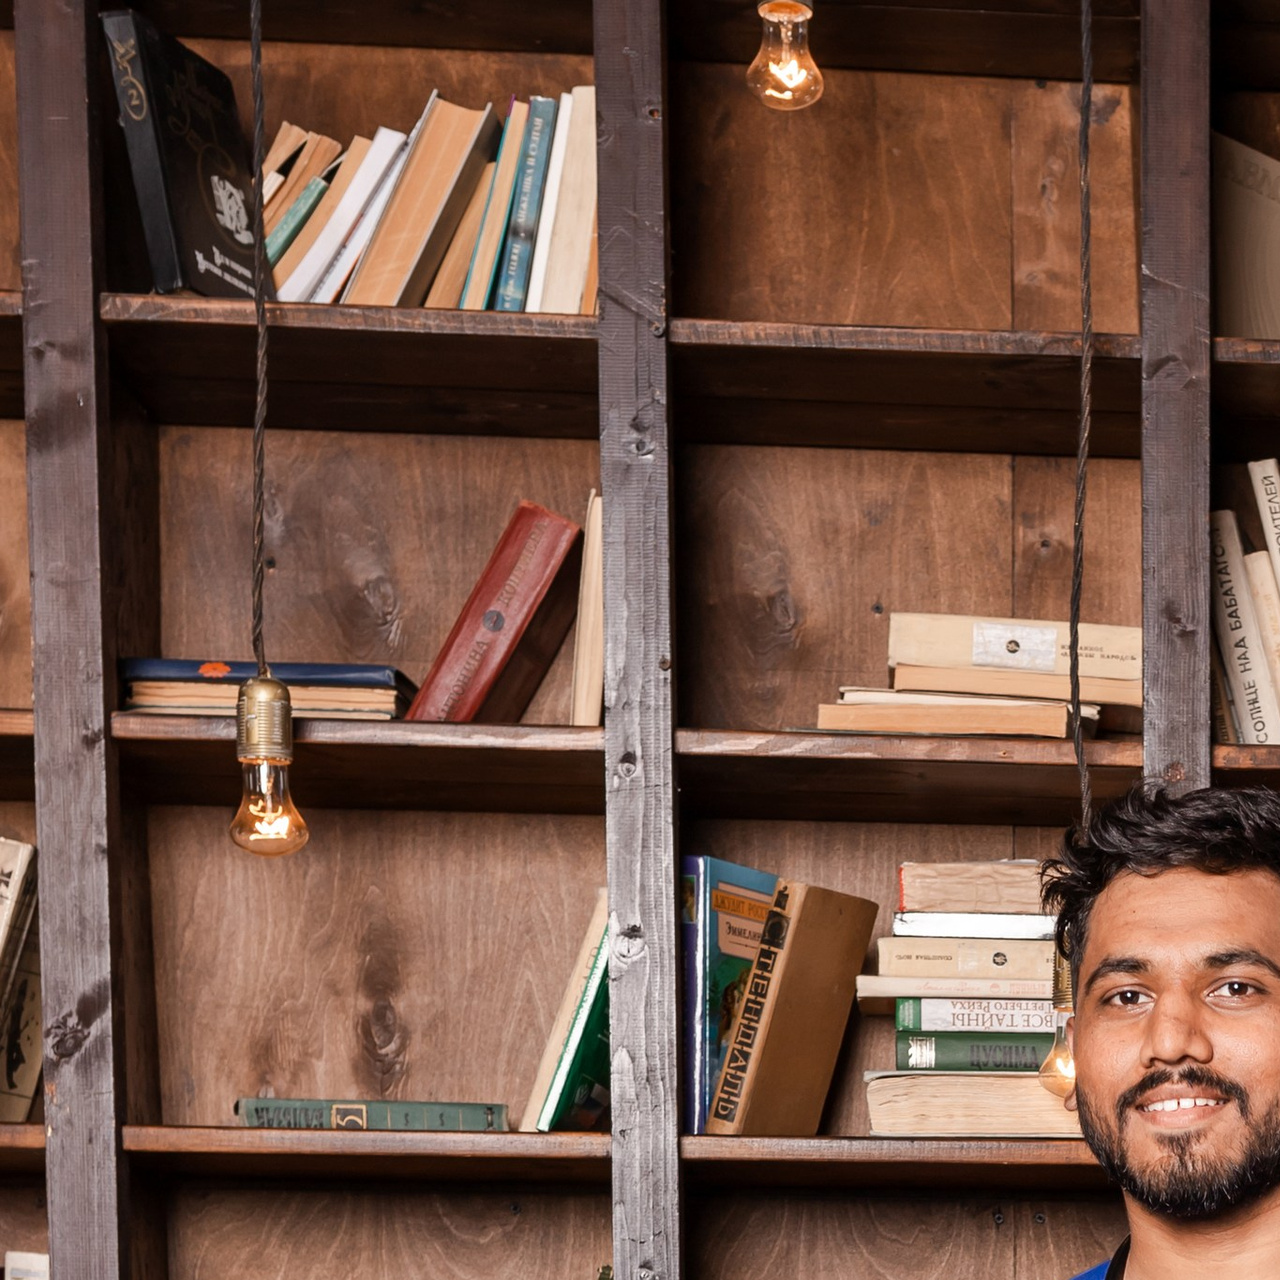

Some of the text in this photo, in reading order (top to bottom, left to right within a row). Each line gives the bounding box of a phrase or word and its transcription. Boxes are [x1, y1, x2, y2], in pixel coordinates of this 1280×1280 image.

[1232, 634, 1269, 745] СОЛНЦЕ НАД
[950, 1012, 1054, 1029] ВСЕ ТАЙНЫ
[969, 1043, 1039, 1070] ЦУСИМА
